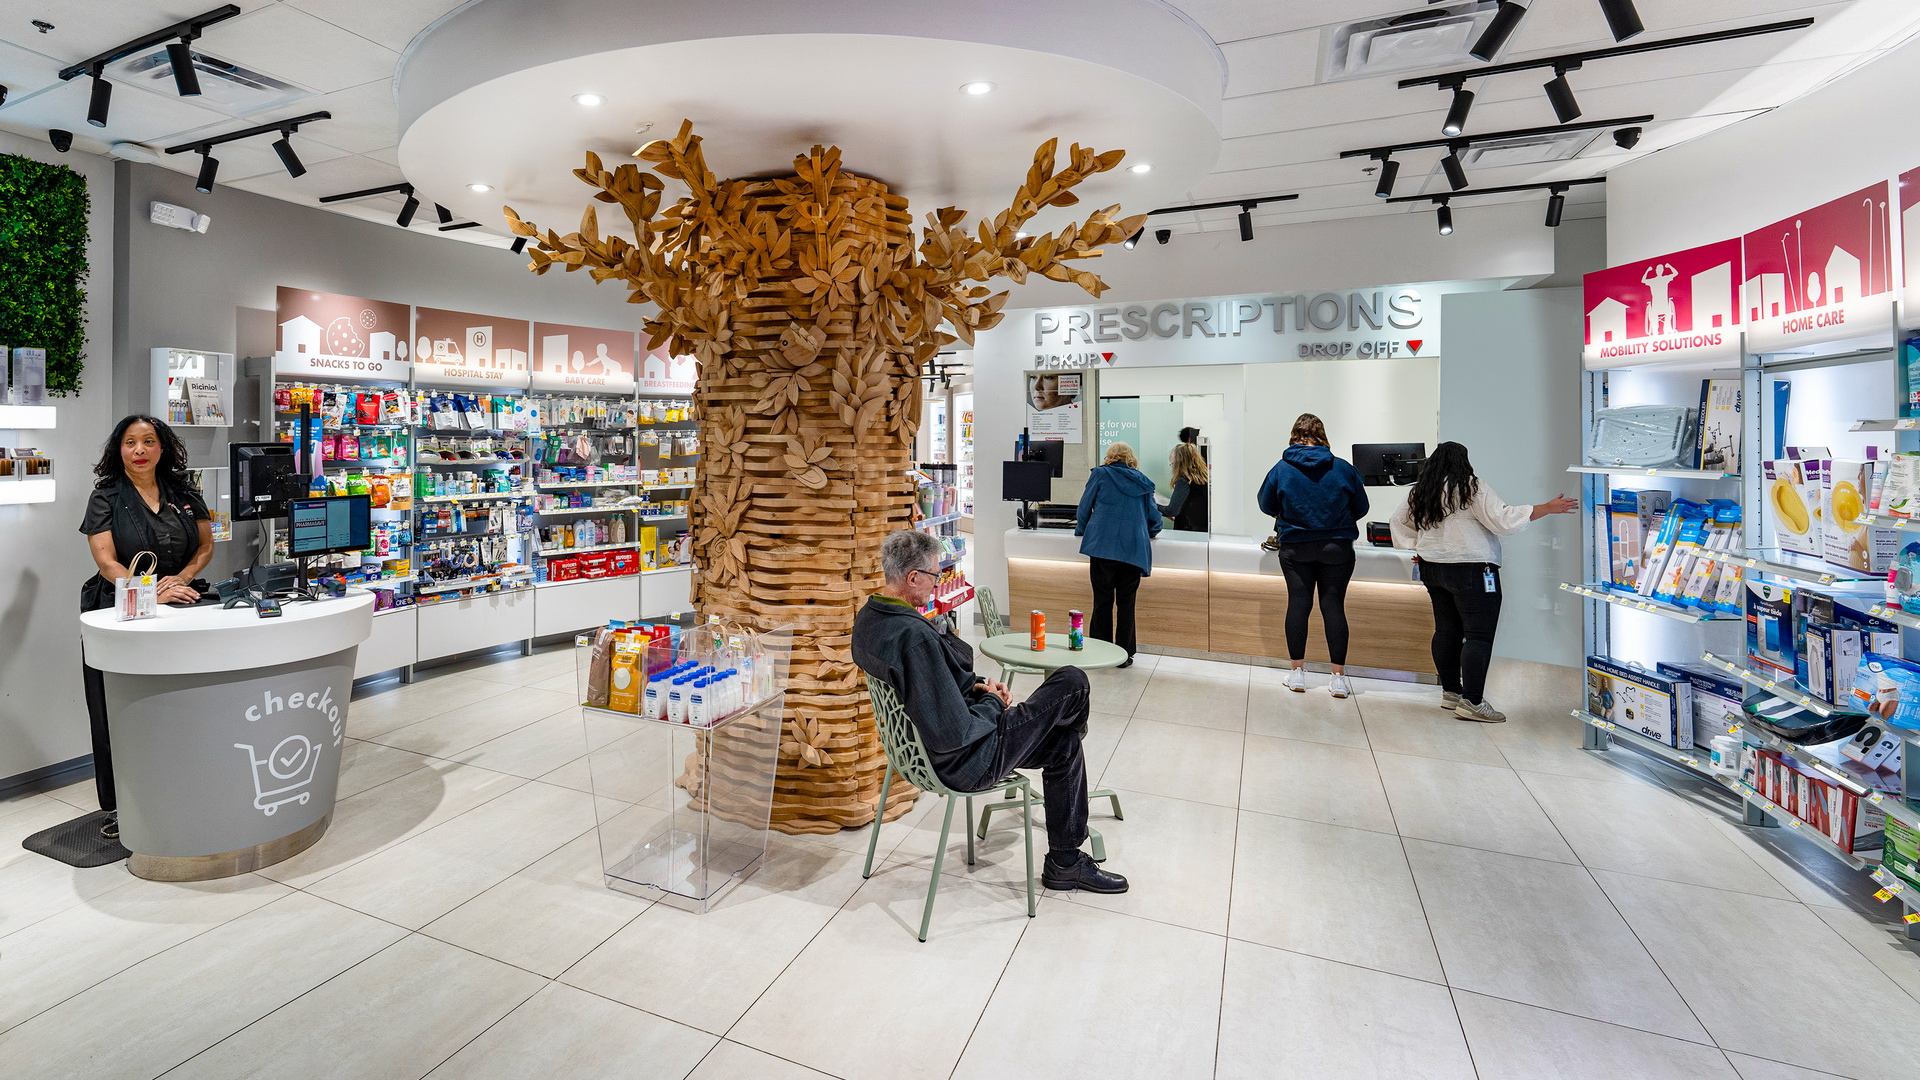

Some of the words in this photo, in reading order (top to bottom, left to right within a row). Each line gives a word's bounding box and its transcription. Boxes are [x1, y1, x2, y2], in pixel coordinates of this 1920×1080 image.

[1034, 289, 1423, 347] PRESCRIPTIONS
[1783, 316, 1813, 334] HOME
[1817, 309, 1845, 328] CARE
[1299, 341, 1353, 357] DROP
[1360, 340, 1400, 355] OFF
[1600, 342, 1649, 358] MOBILITY
[1652, 333, 1722, 352] SOLUTIONS
[310, 358, 350, 369] SNACKS
[352, 361, 365, 370] TO
[368, 362, 383, 372] GO
[1035, 352, 1101, 368] PICK-UP
[444, 368, 483, 379] HOSPITAL
[485, 371, 504, 380] STAY
[565, 376, 585, 385] BABY
[587, 377, 606, 386] CARE
[191, 383, 218, 391] Riciniol
[168, 400, 189, 408] iciniol
[1699, 401, 1707, 425] PEDDLER
[1107, 420, 1119, 428] for
[1121, 421, 1137, 430] you
[1697, 425, 1705, 450] EXERCISE
[295, 520, 325, 528] PHARMASAVE
[1607, 666, 1619, 676] HOME
[1620, 670, 1628, 679] BED
[1628, 673, 1643, 683] ASSIST
[1643, 676, 1660, 689] HANDLE
[245, 686, 342, 747] checkout
[1641, 726, 1662, 740] drive
